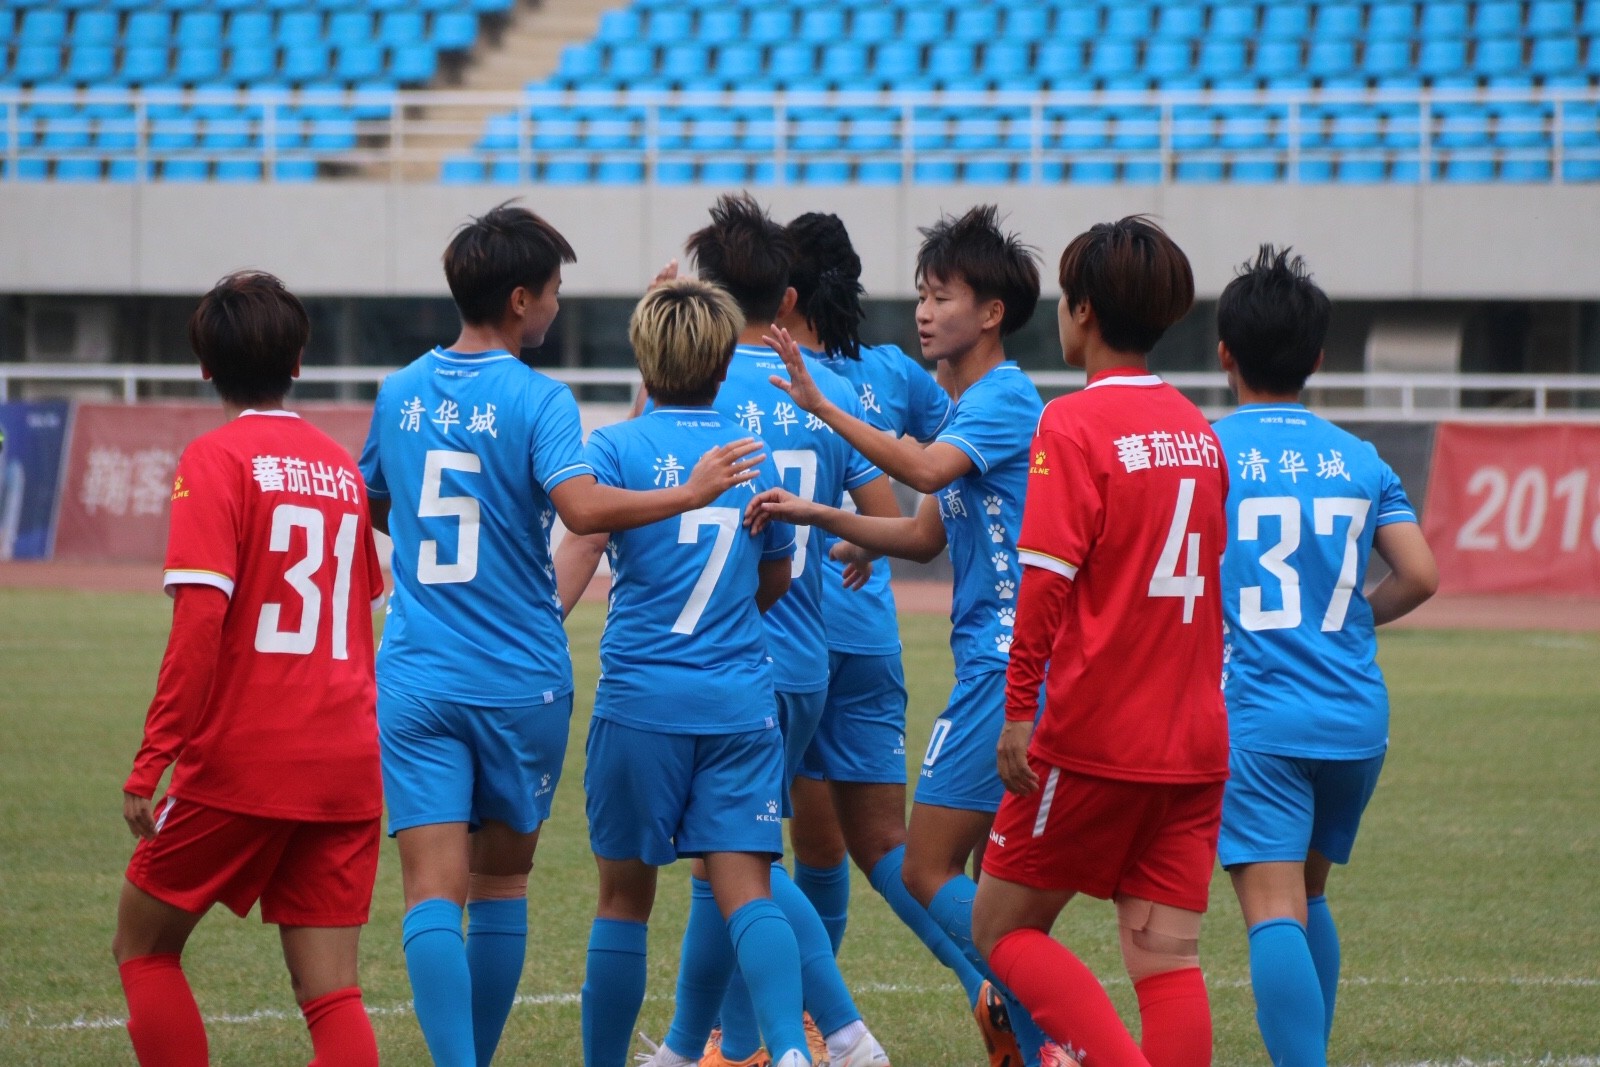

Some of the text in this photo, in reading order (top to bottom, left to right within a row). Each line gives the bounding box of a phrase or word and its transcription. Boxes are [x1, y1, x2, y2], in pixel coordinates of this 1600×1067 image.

[400, 396, 498, 439] 清华城
[1113, 431, 1219, 474] 蕃茄出行
[1237, 448, 1351, 484] 清华城
[252, 455, 360, 504] 蕃茄出行
[417, 450, 481, 584] 5
[1456, 465, 1600, 552] 201
[254, 503, 359, 660] 31
[670, 506, 740, 635] 7
[1148, 478, 1205, 624] 4
[1237, 496, 1372, 632] 37
